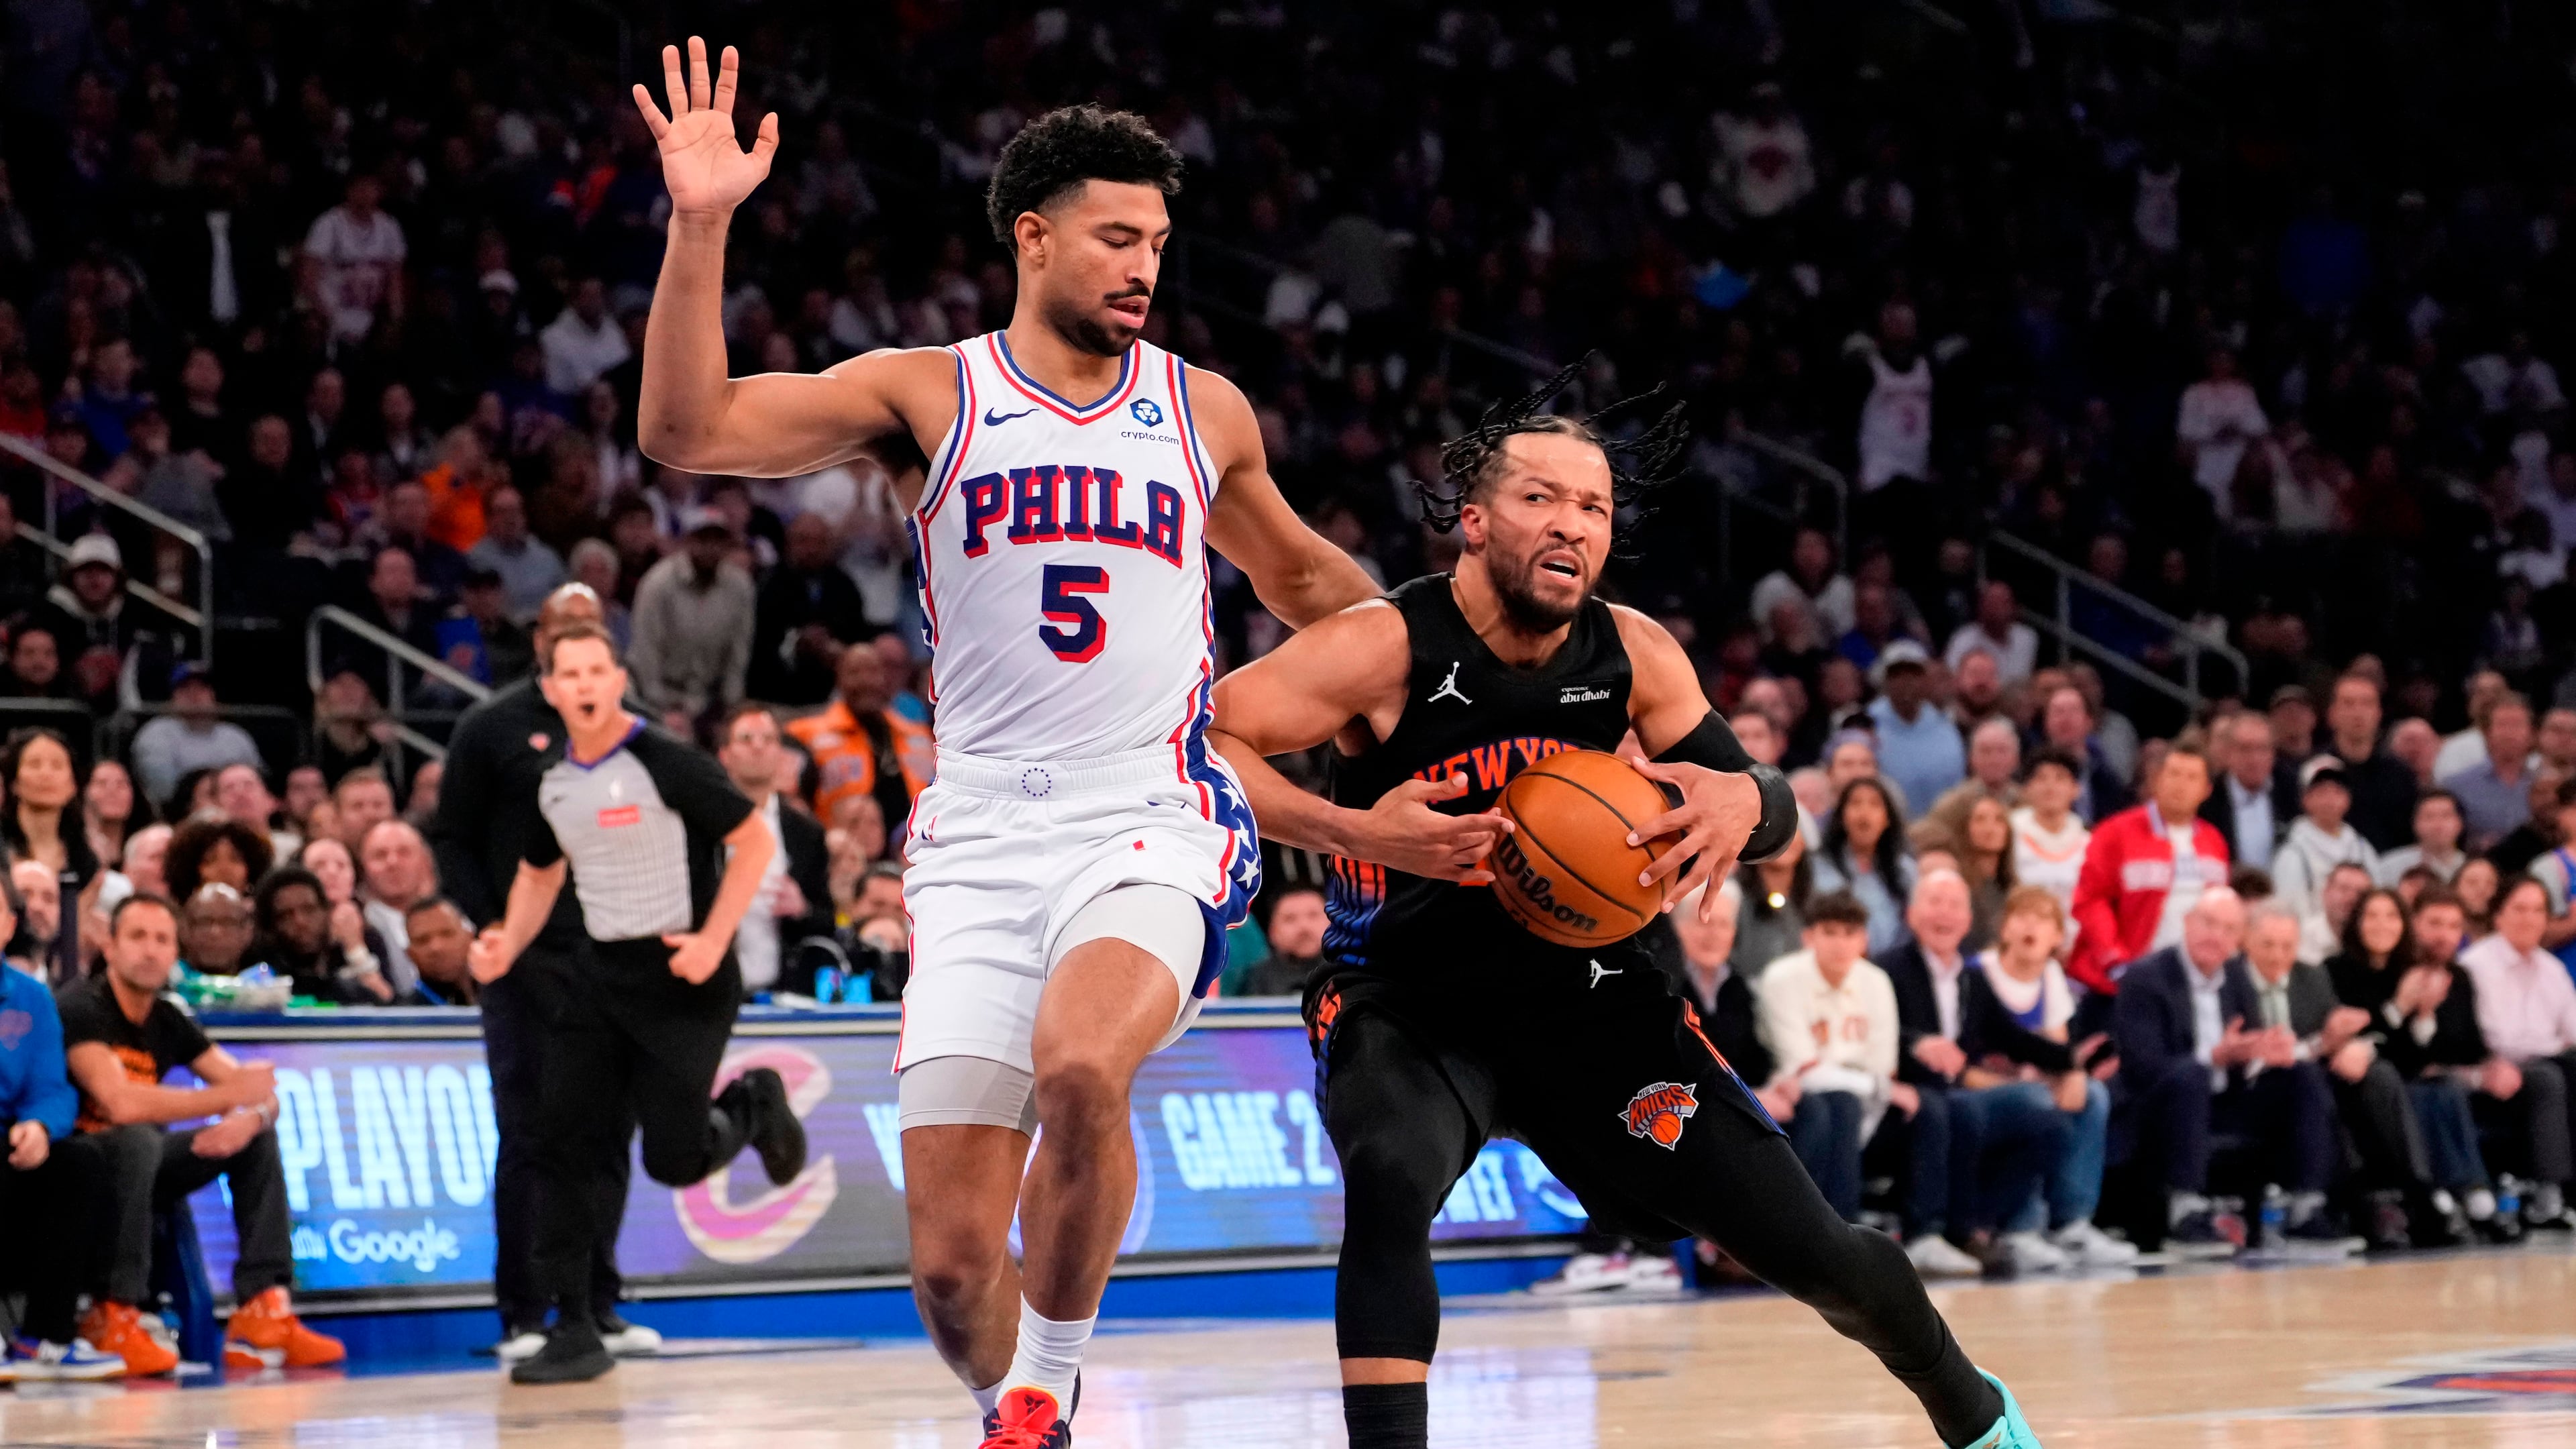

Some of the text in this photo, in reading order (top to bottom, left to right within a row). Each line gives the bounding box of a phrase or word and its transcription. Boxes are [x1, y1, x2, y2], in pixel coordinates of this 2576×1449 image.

[1121, 431, 1179, 445] crypto.com
[961, 465, 1185, 569] PHILA
[1039, 564, 1110, 663] 5
[1560, 689, 1611, 703] abu dhabi
[1499, 833, 1599, 932] Wilson
[1630, 1085, 1697, 1132] KNICKS
[1639, 1083, 1668, 1099] NEW YORK
[1160, 1089, 1336, 1191] GAME 2
[328, 1216, 462, 1273] Google
